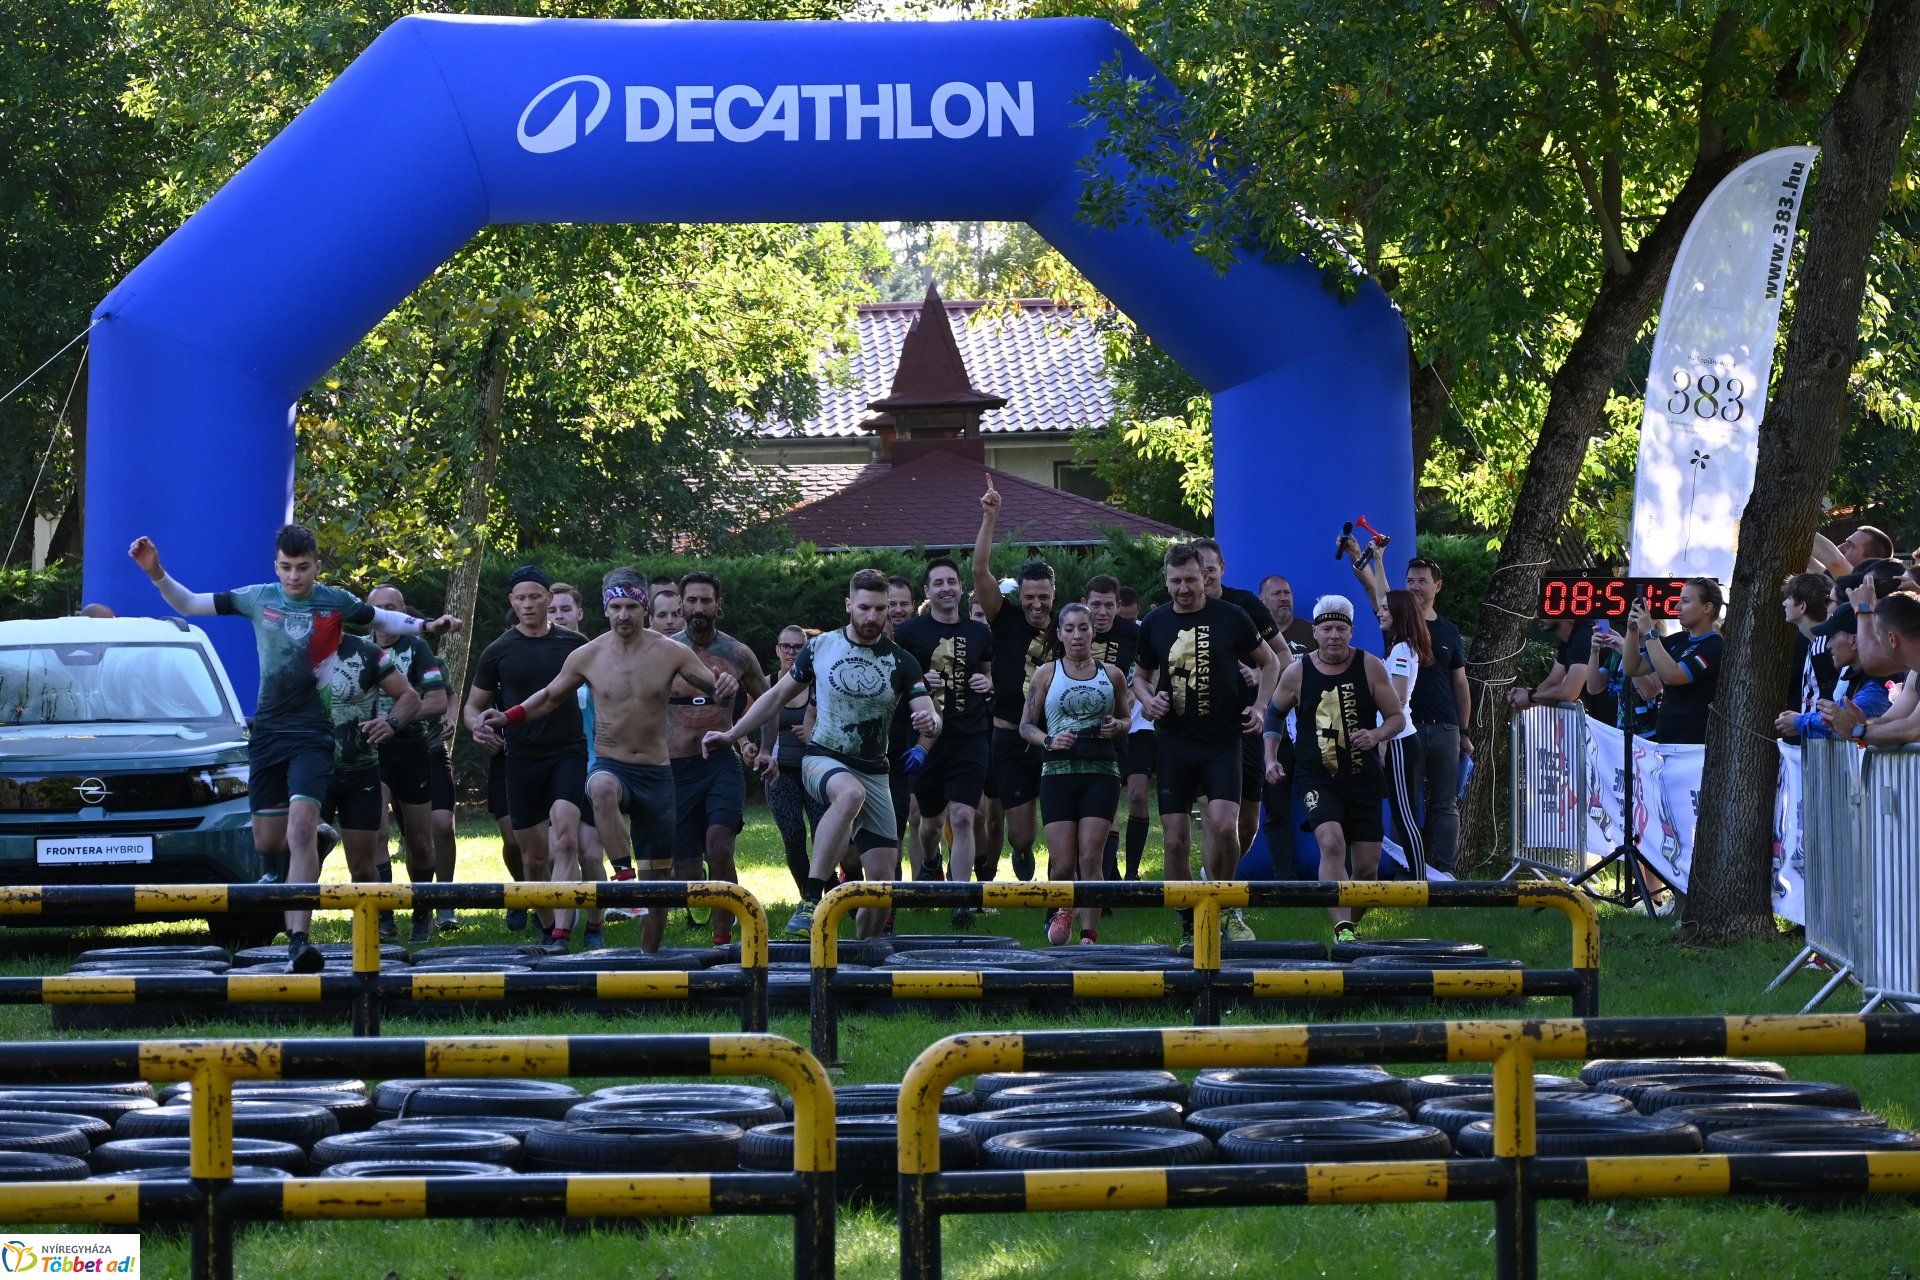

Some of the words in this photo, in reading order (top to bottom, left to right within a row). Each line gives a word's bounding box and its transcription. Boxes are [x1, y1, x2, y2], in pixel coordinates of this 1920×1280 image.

[625, 81, 1035, 142] DECATHLON
[1766, 161, 1805, 300] www.383.hu
[1668, 371, 1744, 423] 383
[954, 636, 966, 712] FARKASFALKA
[1197, 625, 1210, 716] FARKASFALKA
[46, 846, 103, 855] FRONTERA
[106, 845, 144, 854] HYBRID
